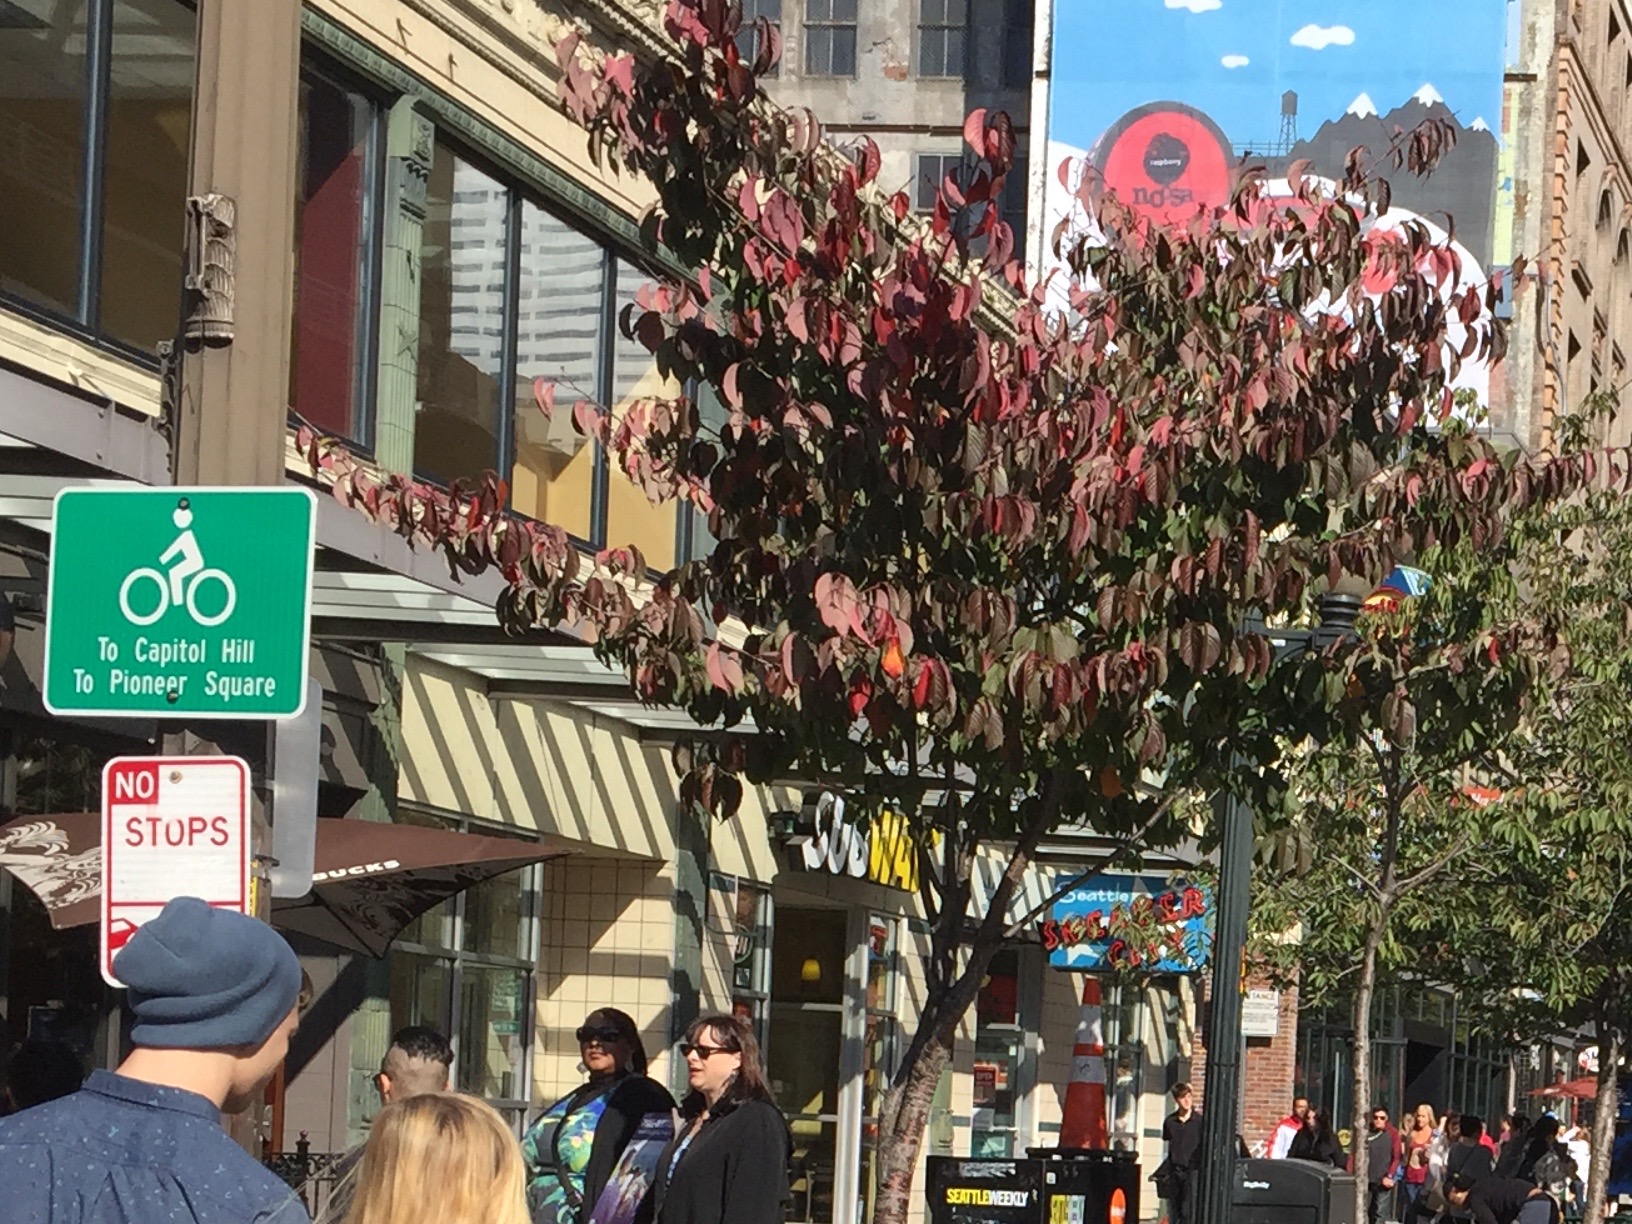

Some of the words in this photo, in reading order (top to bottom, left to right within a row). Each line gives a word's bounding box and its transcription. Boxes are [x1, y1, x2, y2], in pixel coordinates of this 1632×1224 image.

[97, 636, 119, 663] To
[134, 636, 206, 668] Capitol
[221, 638, 255, 664] Hill
[73, 668, 95, 694] To
[109, 668, 188, 695] Pioneer
[204, 670, 277, 702] Square
[115, 770, 155, 799] NO
[125, 816, 229, 847] STOPS
[801, 790, 942, 894] SUBWA
[1056, 881, 1131, 904] Seattle
